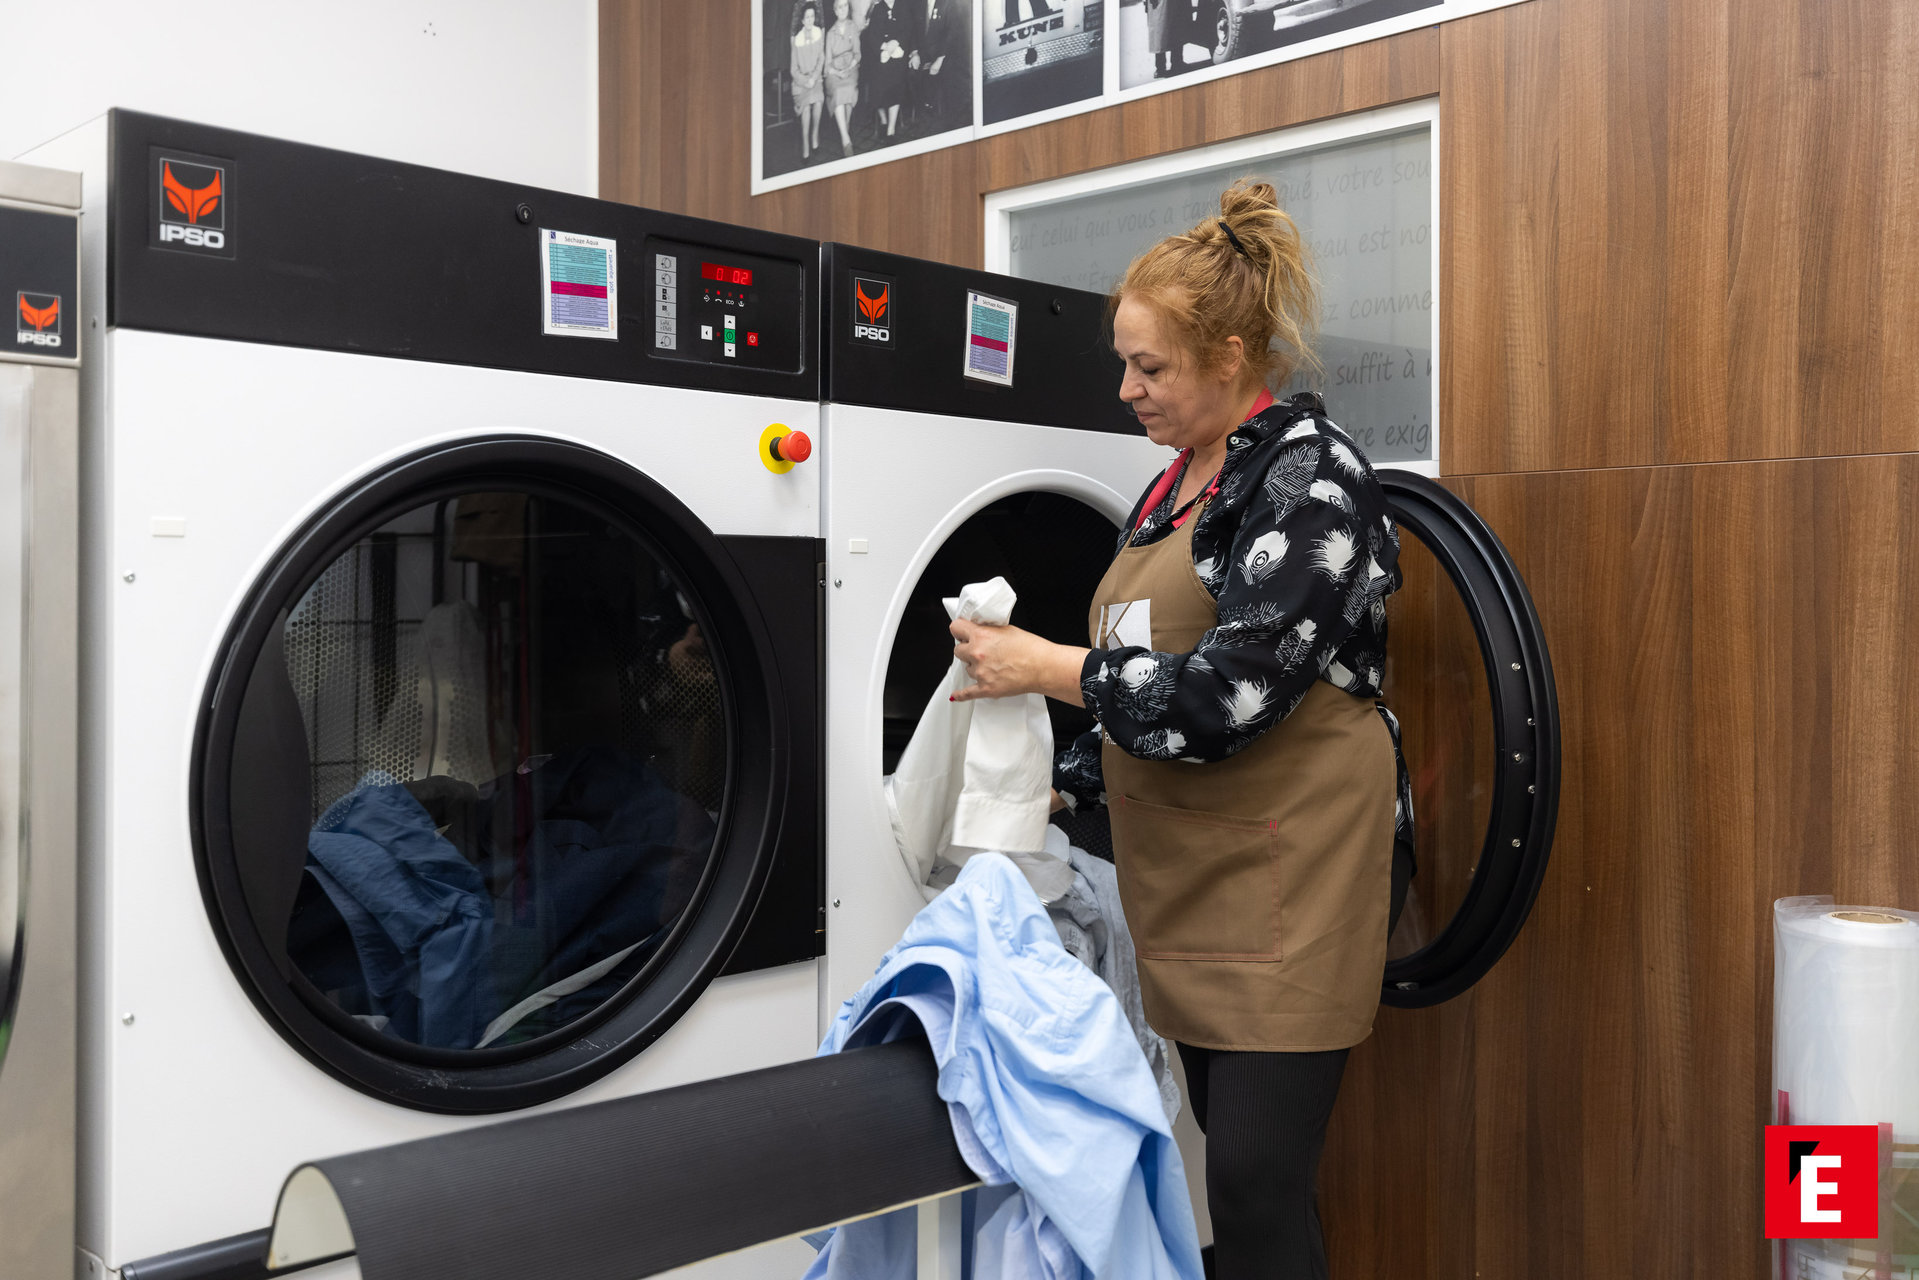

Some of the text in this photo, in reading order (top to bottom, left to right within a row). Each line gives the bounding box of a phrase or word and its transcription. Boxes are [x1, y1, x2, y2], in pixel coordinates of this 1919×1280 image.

[1042, 216, 1079, 248] celui
[1085, 209, 1111, 247] qui
[1118, 208, 1156, 233] vous
[1163, 205, 1174, 225] a
[1327, 166, 1384, 195] votre
[159, 223, 225, 249] IPSO
[1359, 224, 1391, 253] est
[716, 267, 749, 285] 0 02
[1350, 289, 1431, 319] comme
[17, 331, 62, 347] IPSO
[855, 325, 890, 342] IPSO
[1336, 351, 1394, 386] suffit
[1403, 348, 1416, 379] à
